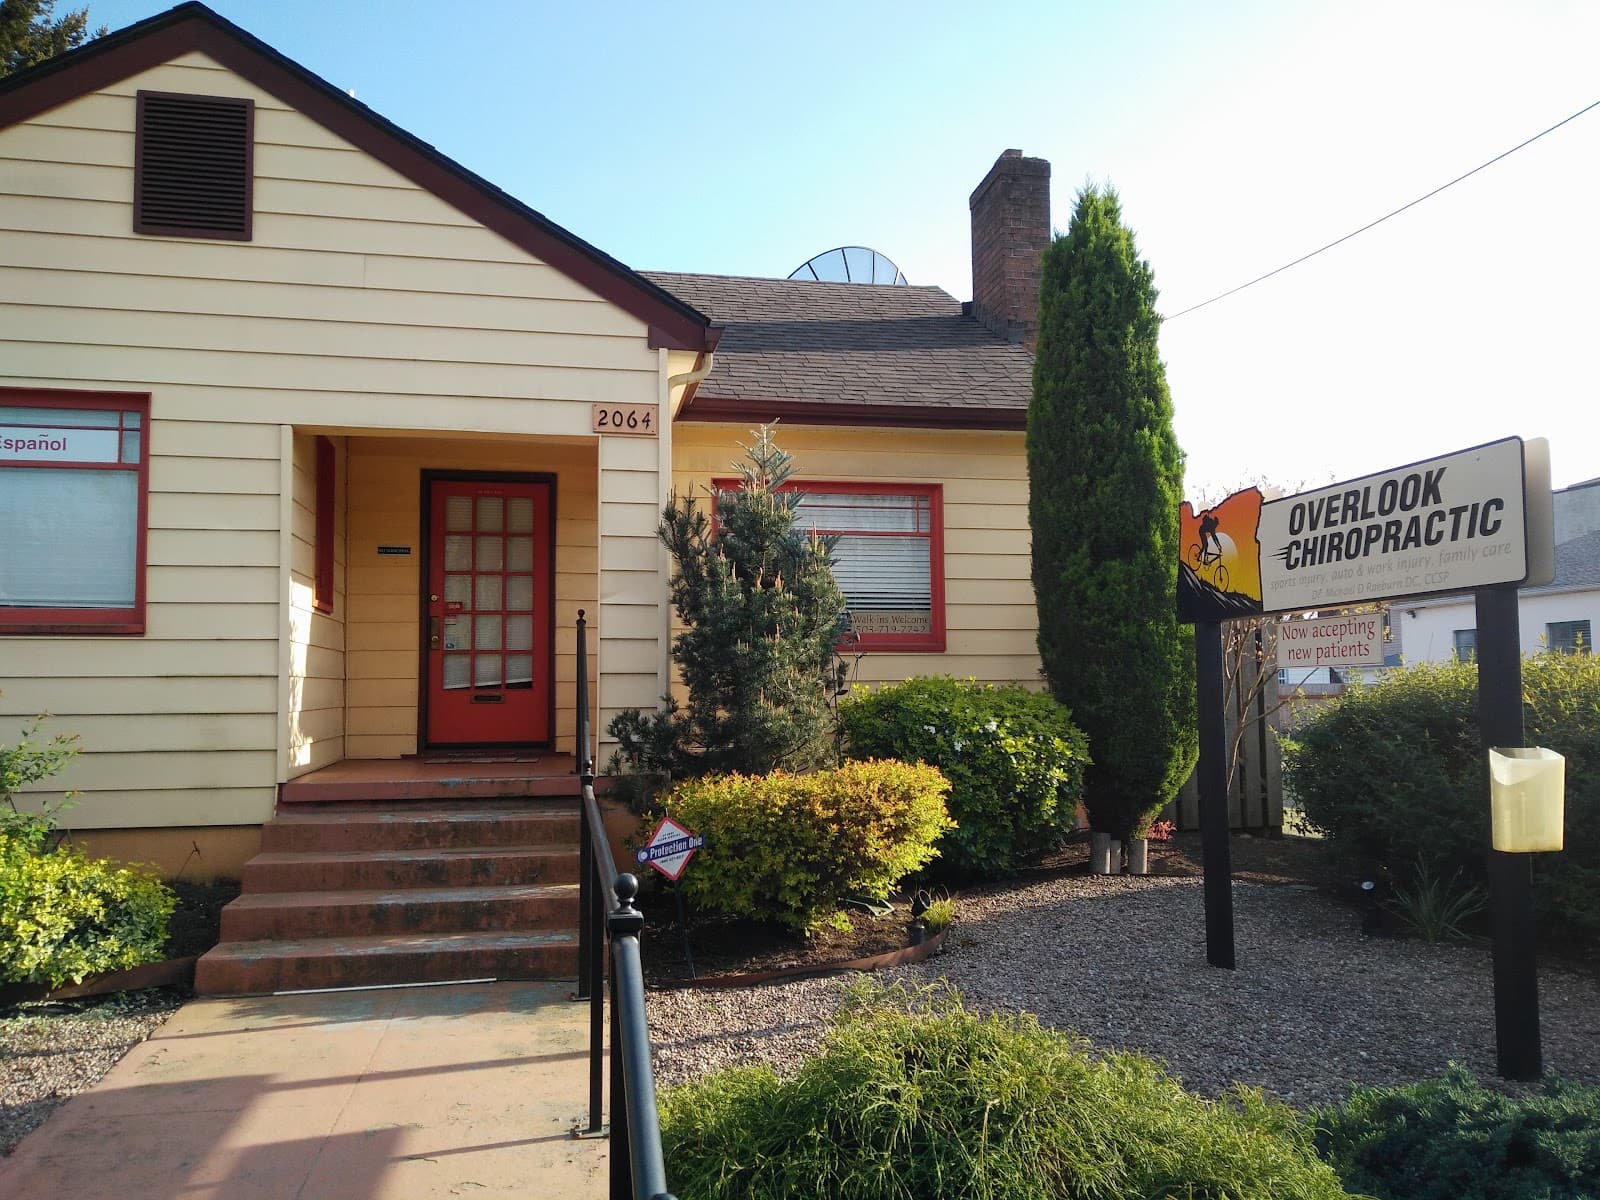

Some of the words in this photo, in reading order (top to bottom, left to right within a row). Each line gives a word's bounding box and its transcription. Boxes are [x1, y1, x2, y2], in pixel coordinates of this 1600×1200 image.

[598, 409, 651, 430] 2064
[0, 433, 67, 453] spañol
[1289, 467, 1448, 536] OVERLOOK
[1284, 497, 1505, 571] CHIROPRACTIC
[1270, 576, 1296, 592] sports
[1332, 569, 1354, 581] auto
[1356, 566, 1364, 576] &
[1368, 561, 1393, 575] work
[1397, 555, 1434, 573] injury,
[1438, 544, 1478, 567] family
[1482, 542, 1512, 558] care
[891, 615, 928, 625] Welcome
[1282, 625, 1308, 640] Now
[1312, 618, 1375, 641] accepting
[1288, 647, 1312, 660] new
[1316, 641, 1370, 664] patients
[650, 841, 687, 859] Protection
[689, 836, 703, 848] One
